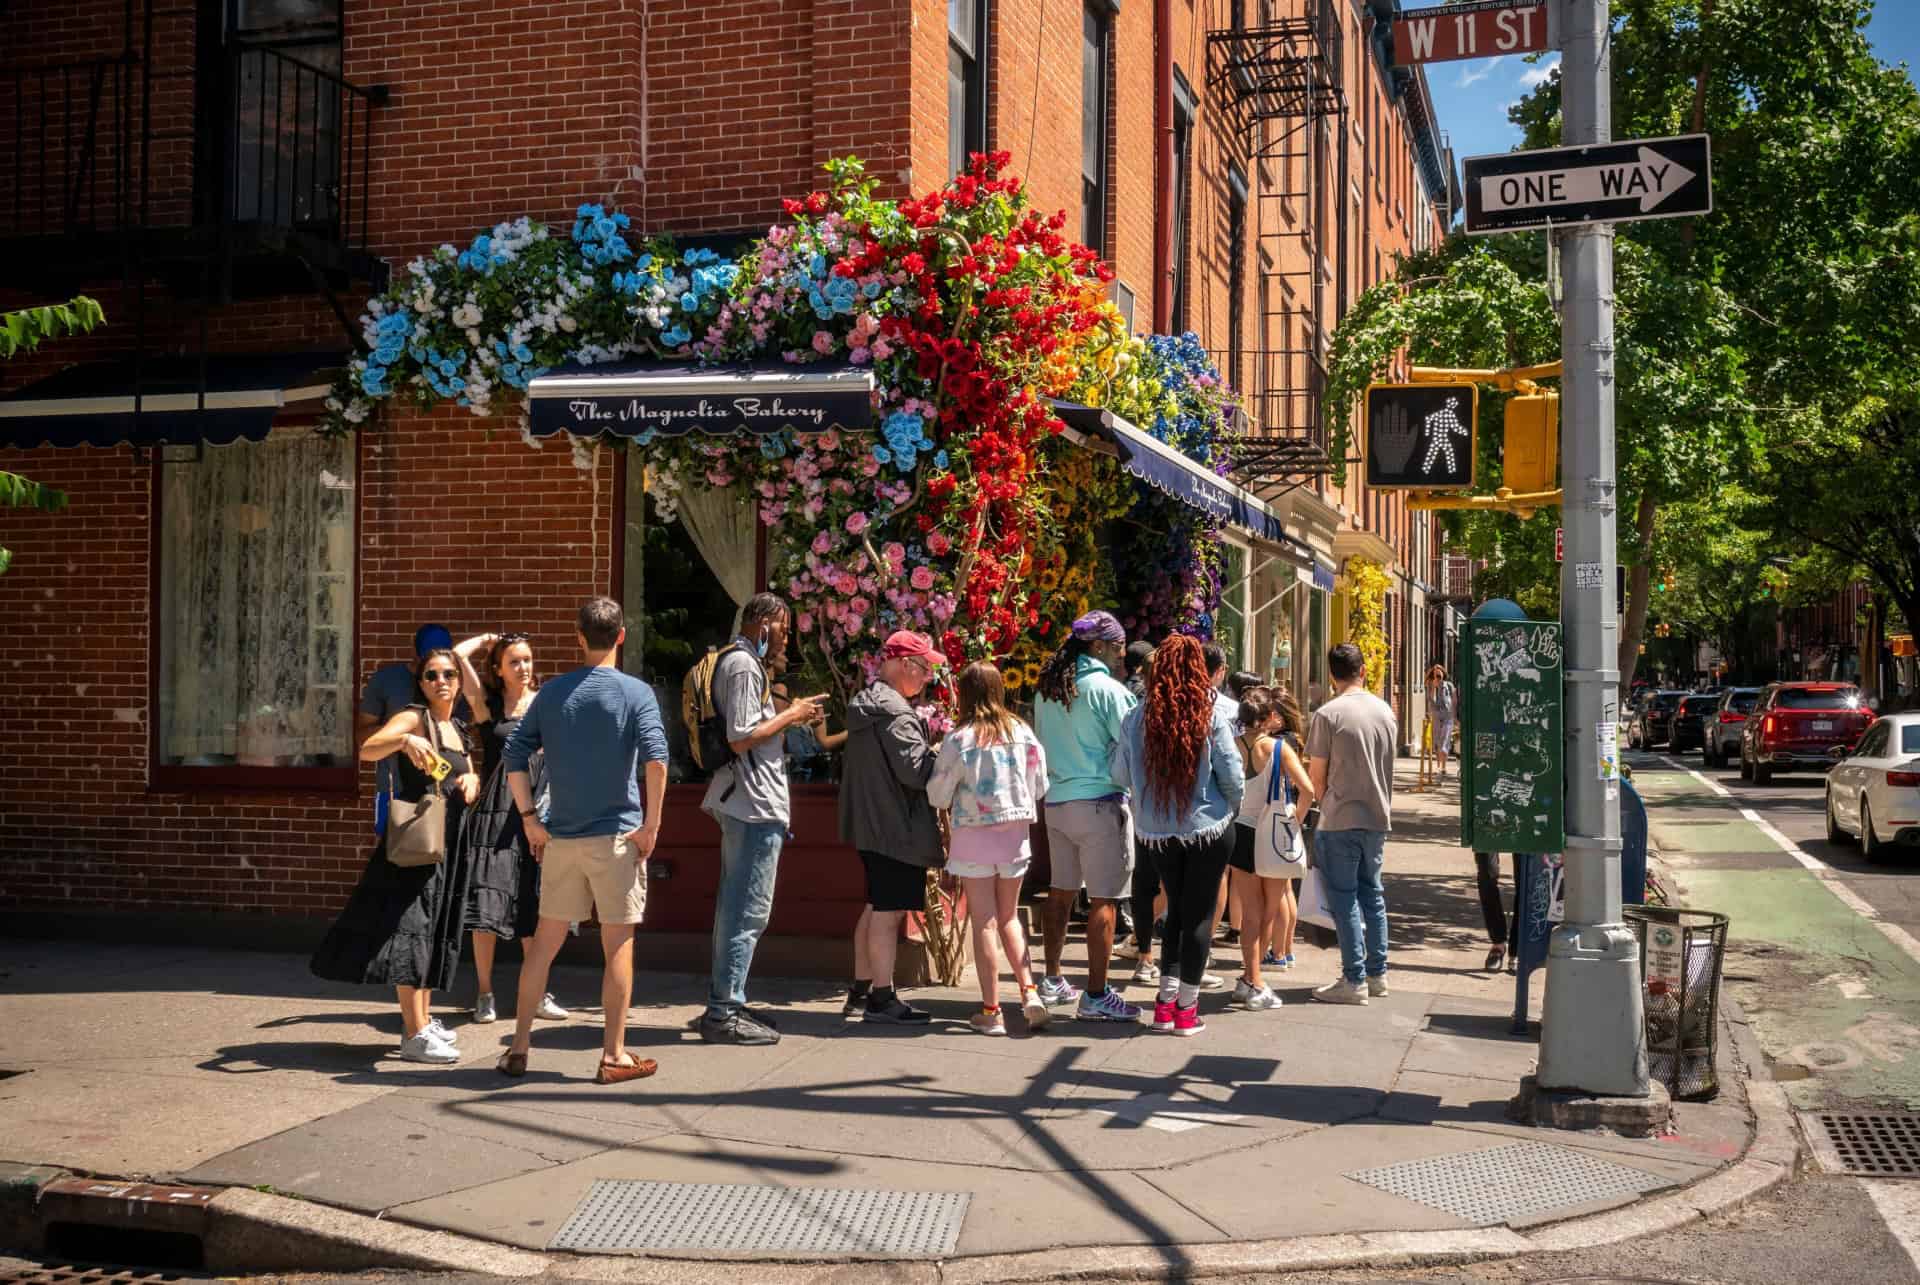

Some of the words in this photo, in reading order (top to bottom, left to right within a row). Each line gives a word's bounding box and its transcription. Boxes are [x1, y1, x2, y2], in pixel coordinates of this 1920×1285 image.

[1407, 18, 1437, 60] W
[1454, 14, 1476, 55] 11
[1495, 6, 1538, 50] ST
[1499, 173, 1567, 206] ONE
[1599, 163, 1671, 197] WAY
[568, 400, 615, 421] The
[619, 399, 731, 426] Magnolia
[733, 397, 828, 425] Bakery
